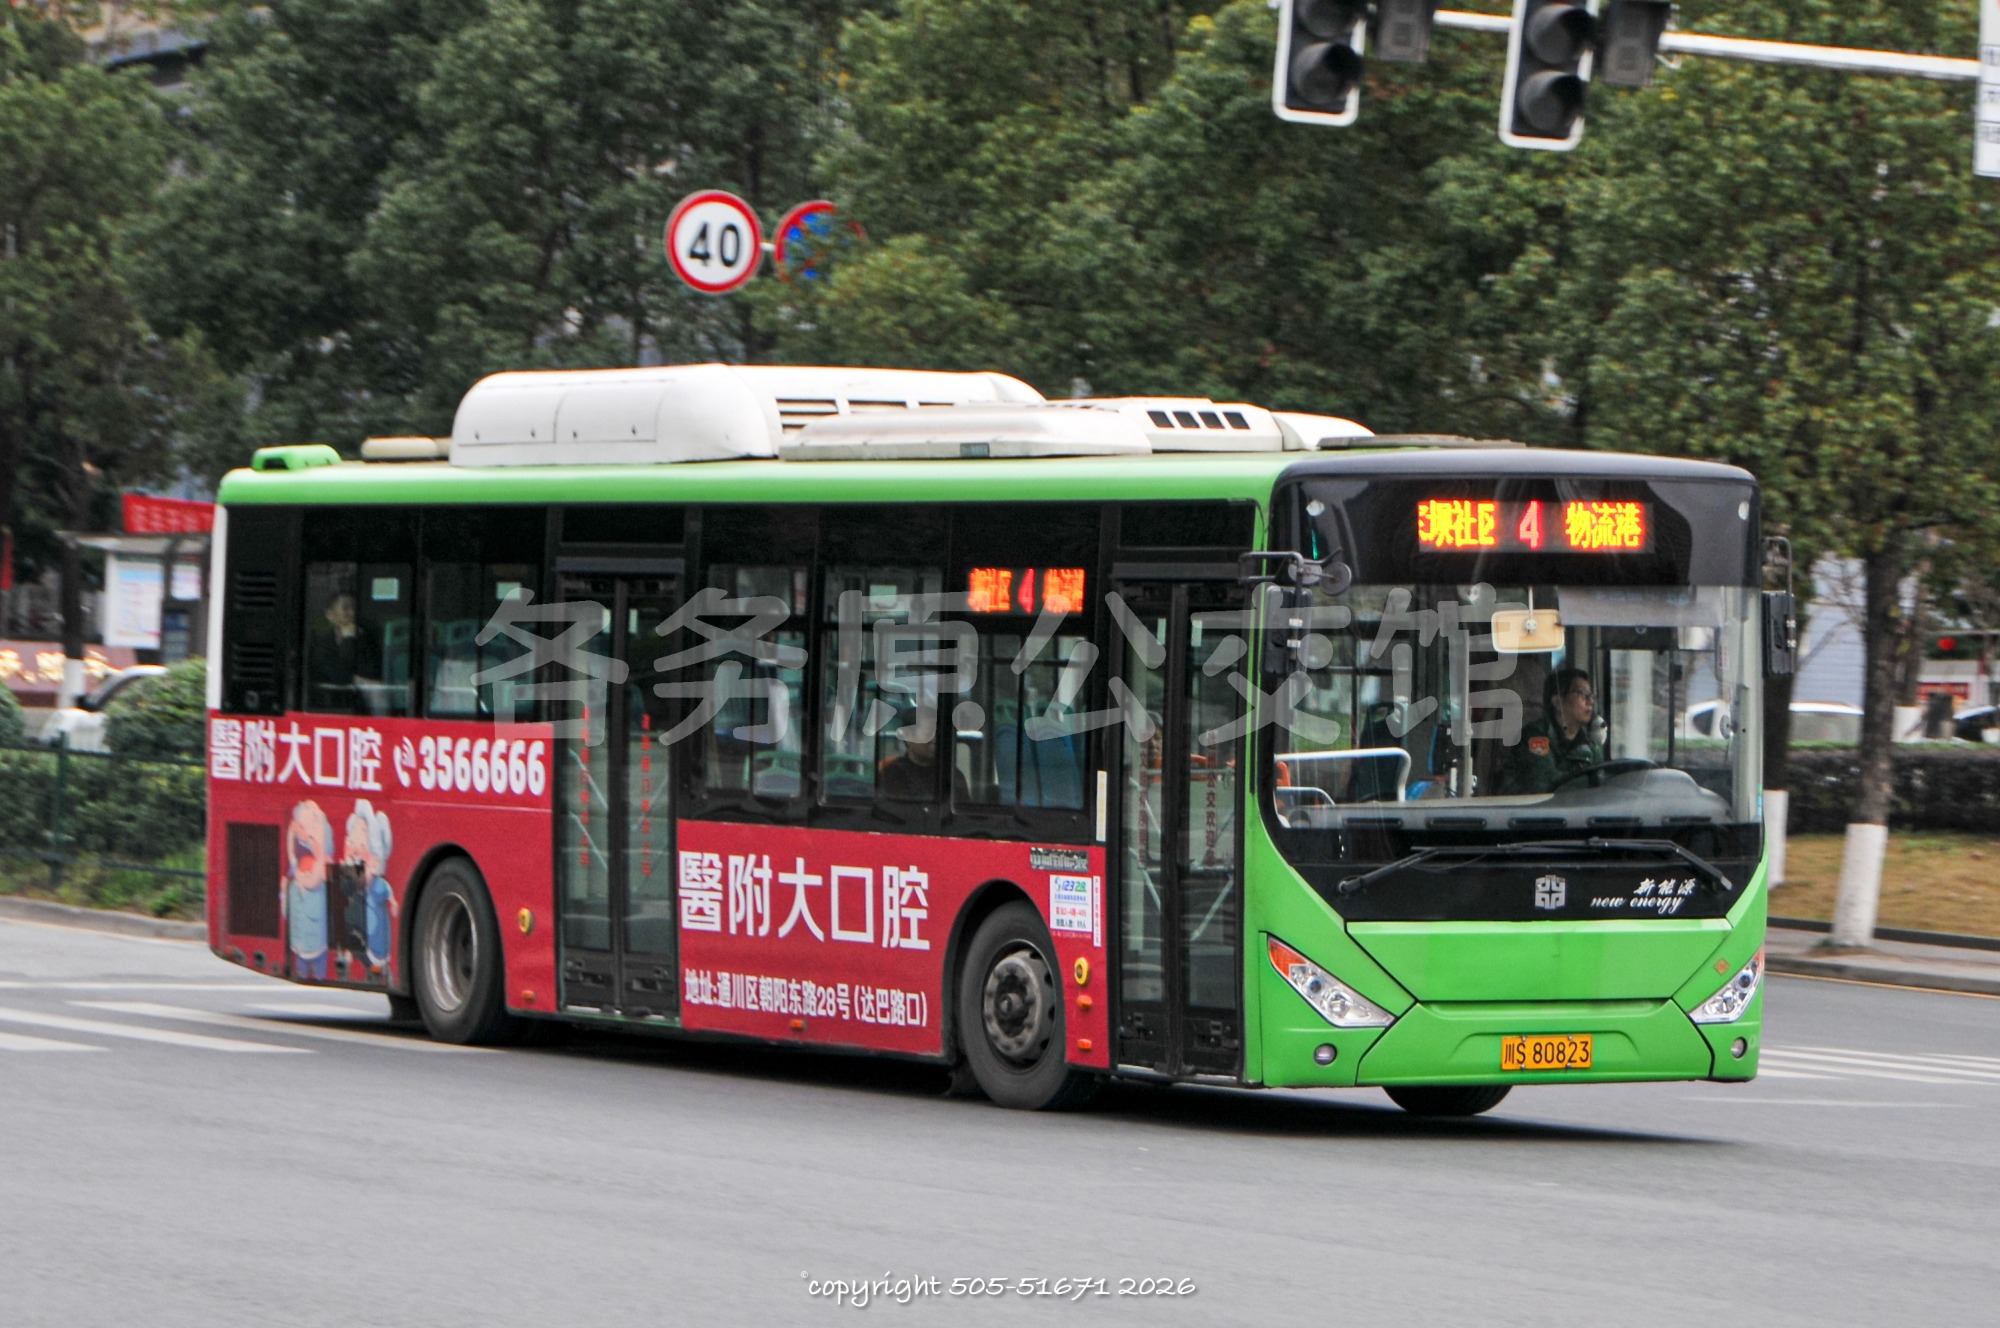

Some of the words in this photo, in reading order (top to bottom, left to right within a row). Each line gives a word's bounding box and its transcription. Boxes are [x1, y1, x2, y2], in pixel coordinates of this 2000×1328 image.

[689, 222, 740, 267] 40
[1519, 500, 1542, 548] 4
[1564, 501, 1643, 548] 物流港
[210, 717, 383, 791] 醫附大口腔
[418, 735, 546, 796] 3566666
[678, 850, 931, 950] 醫附大口腔
[1590, 896, 1625, 908] new
[1630, 894, 1685, 914] energy
[1633, 877, 1697, 897] 新能源
